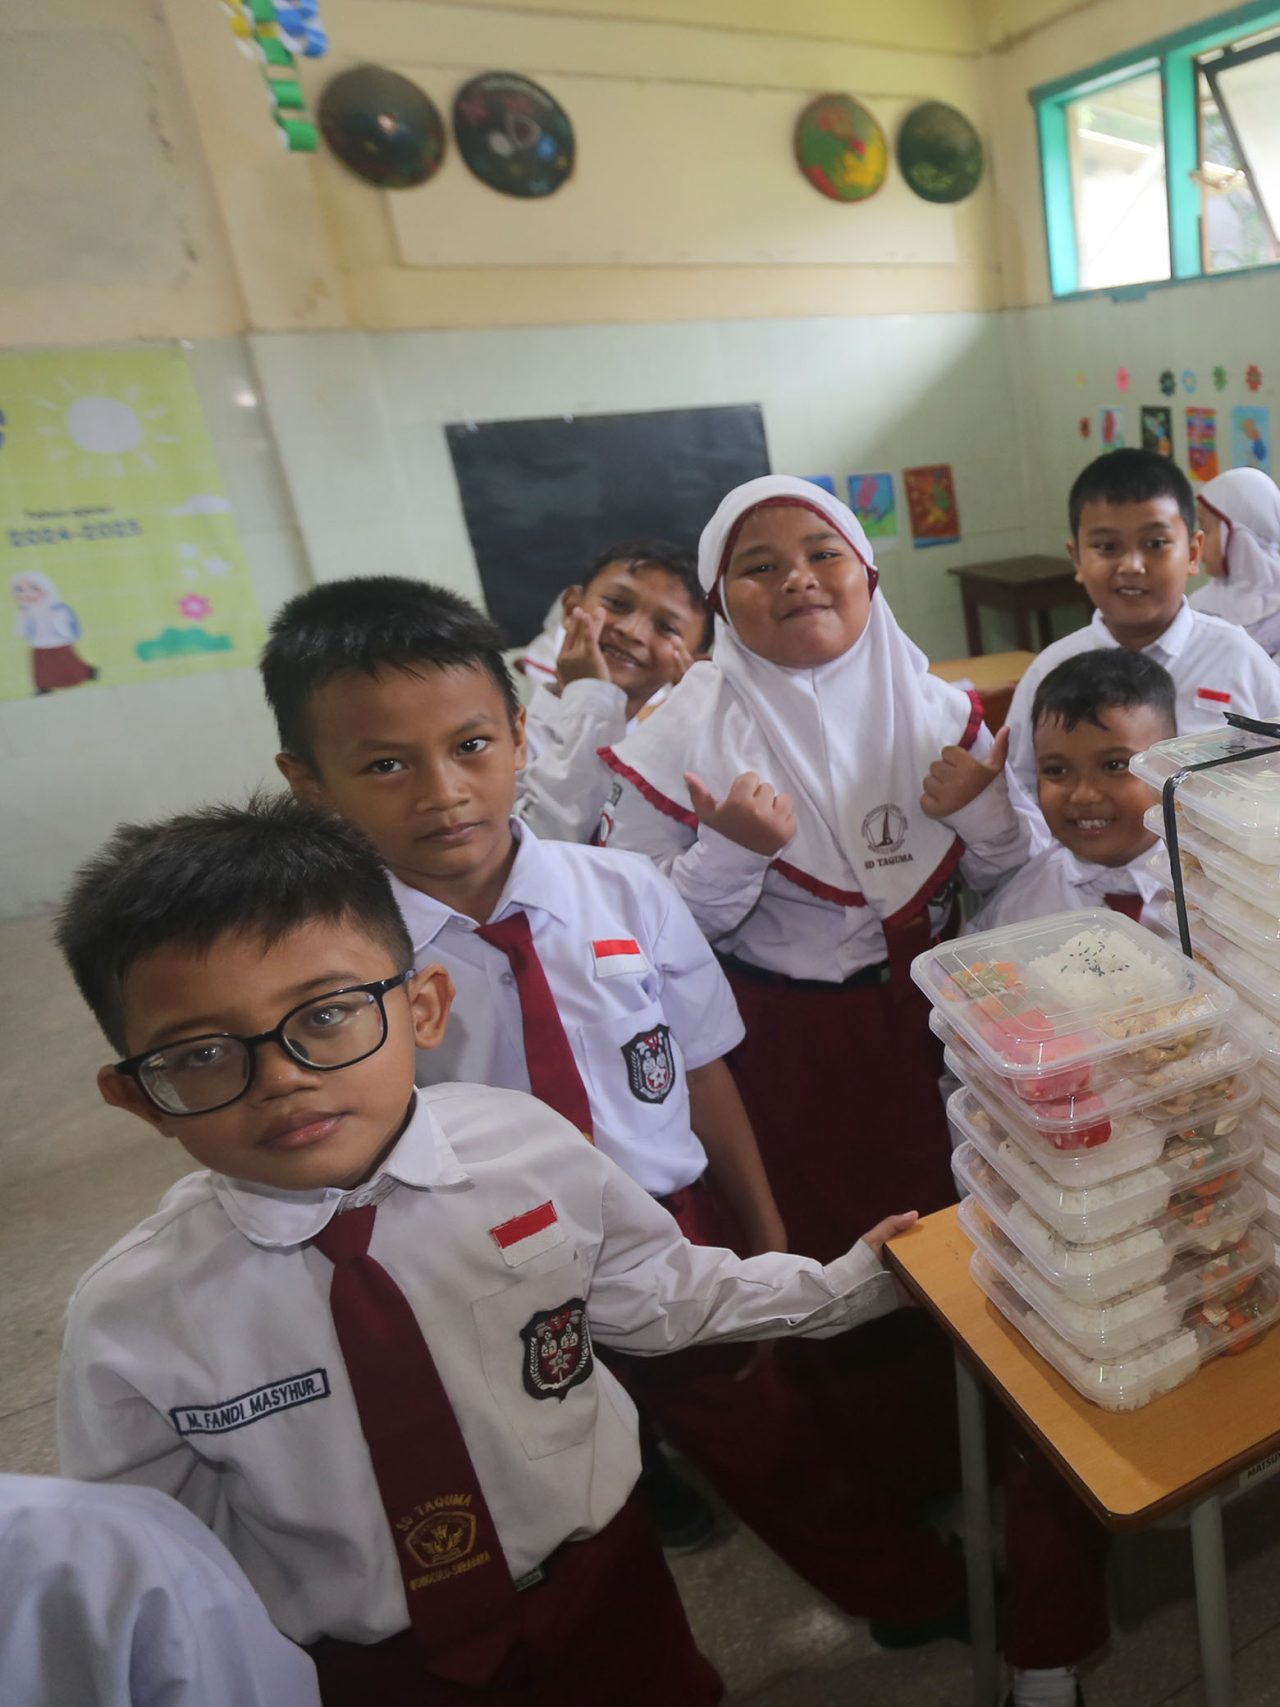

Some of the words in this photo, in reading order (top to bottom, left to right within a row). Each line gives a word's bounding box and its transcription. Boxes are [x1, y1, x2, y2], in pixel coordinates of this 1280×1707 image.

[877, 853, 914, 867] TAQUMA
[204, 1403, 246, 1429] FANDI
[414, 1494, 473, 1515] TAQUMA
